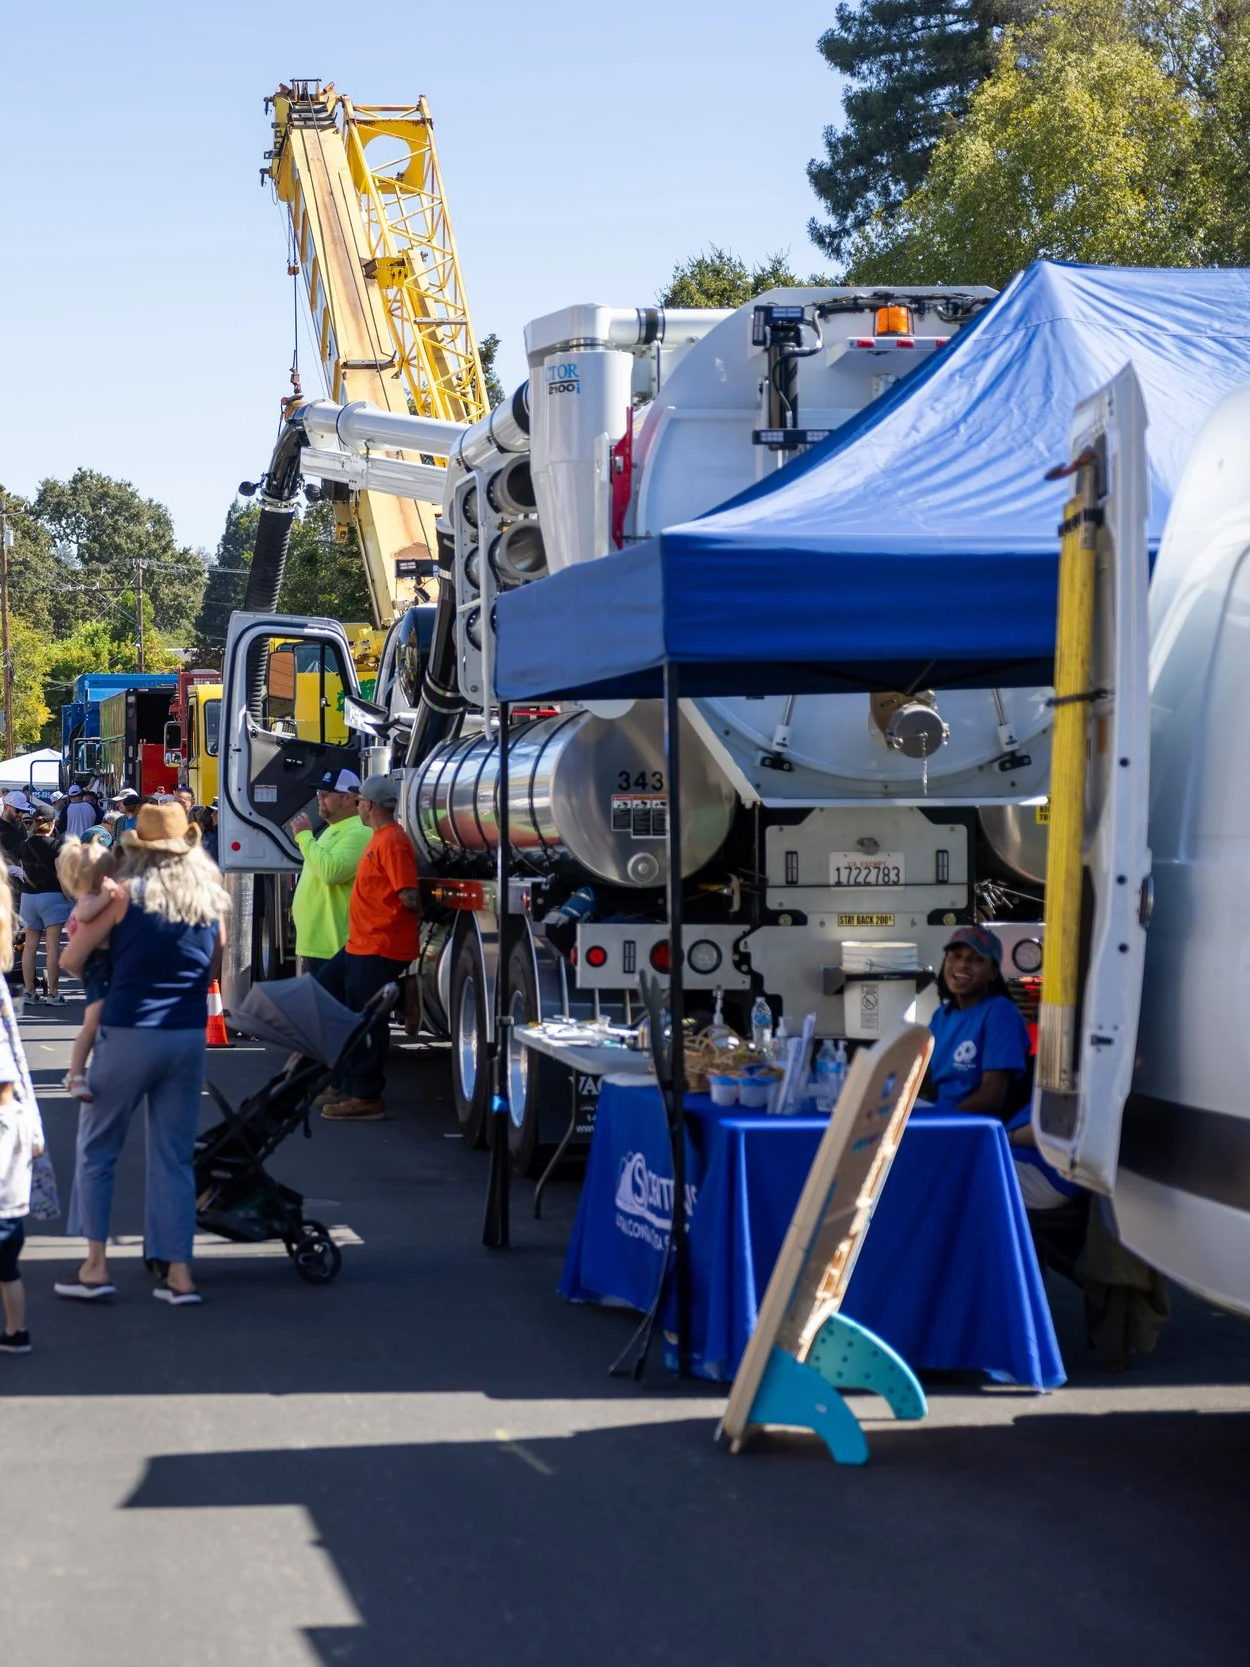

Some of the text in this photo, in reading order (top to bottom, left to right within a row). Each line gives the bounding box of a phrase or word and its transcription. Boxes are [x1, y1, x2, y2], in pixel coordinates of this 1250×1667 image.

[548, 383, 580, 395] 2100i
[617, 770, 664, 791] 343
[834, 866, 901, 885] 1722783
[839, 915, 855, 925] STAY
[856, 915, 874, 925] BACK
